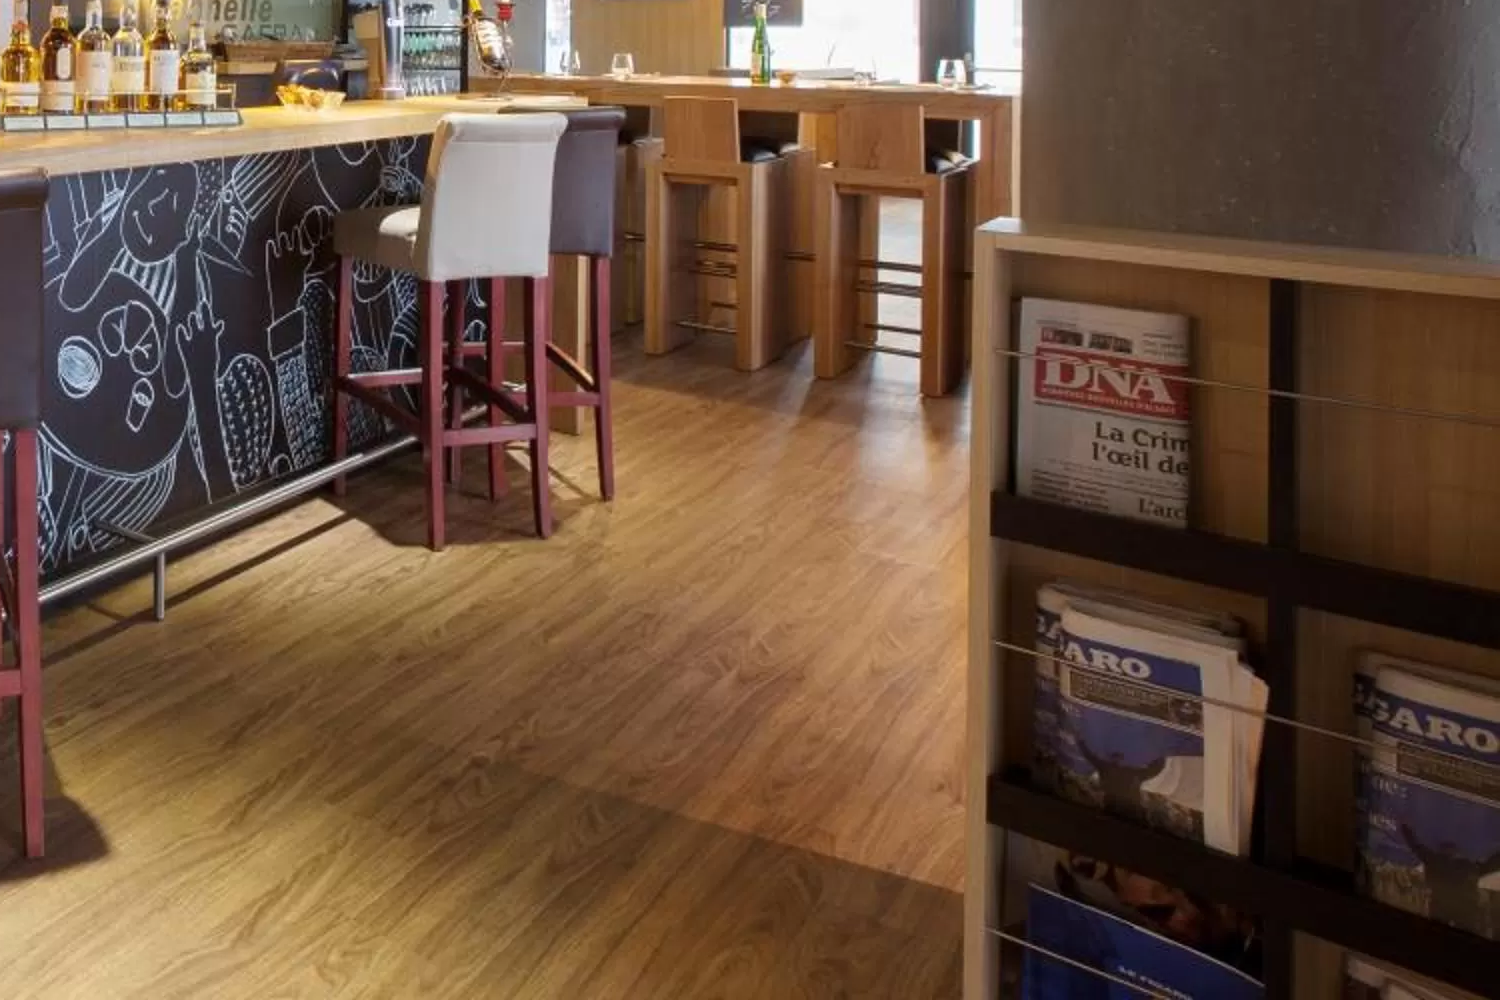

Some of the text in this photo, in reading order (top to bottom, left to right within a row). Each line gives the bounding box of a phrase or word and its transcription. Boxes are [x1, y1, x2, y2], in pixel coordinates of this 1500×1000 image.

[1042, 350, 1177, 406] DNA
[1095, 421, 1190, 454] La Crim
[1091, 441, 1190, 477] l'œil de
[1059, 636, 1153, 680] ARO
